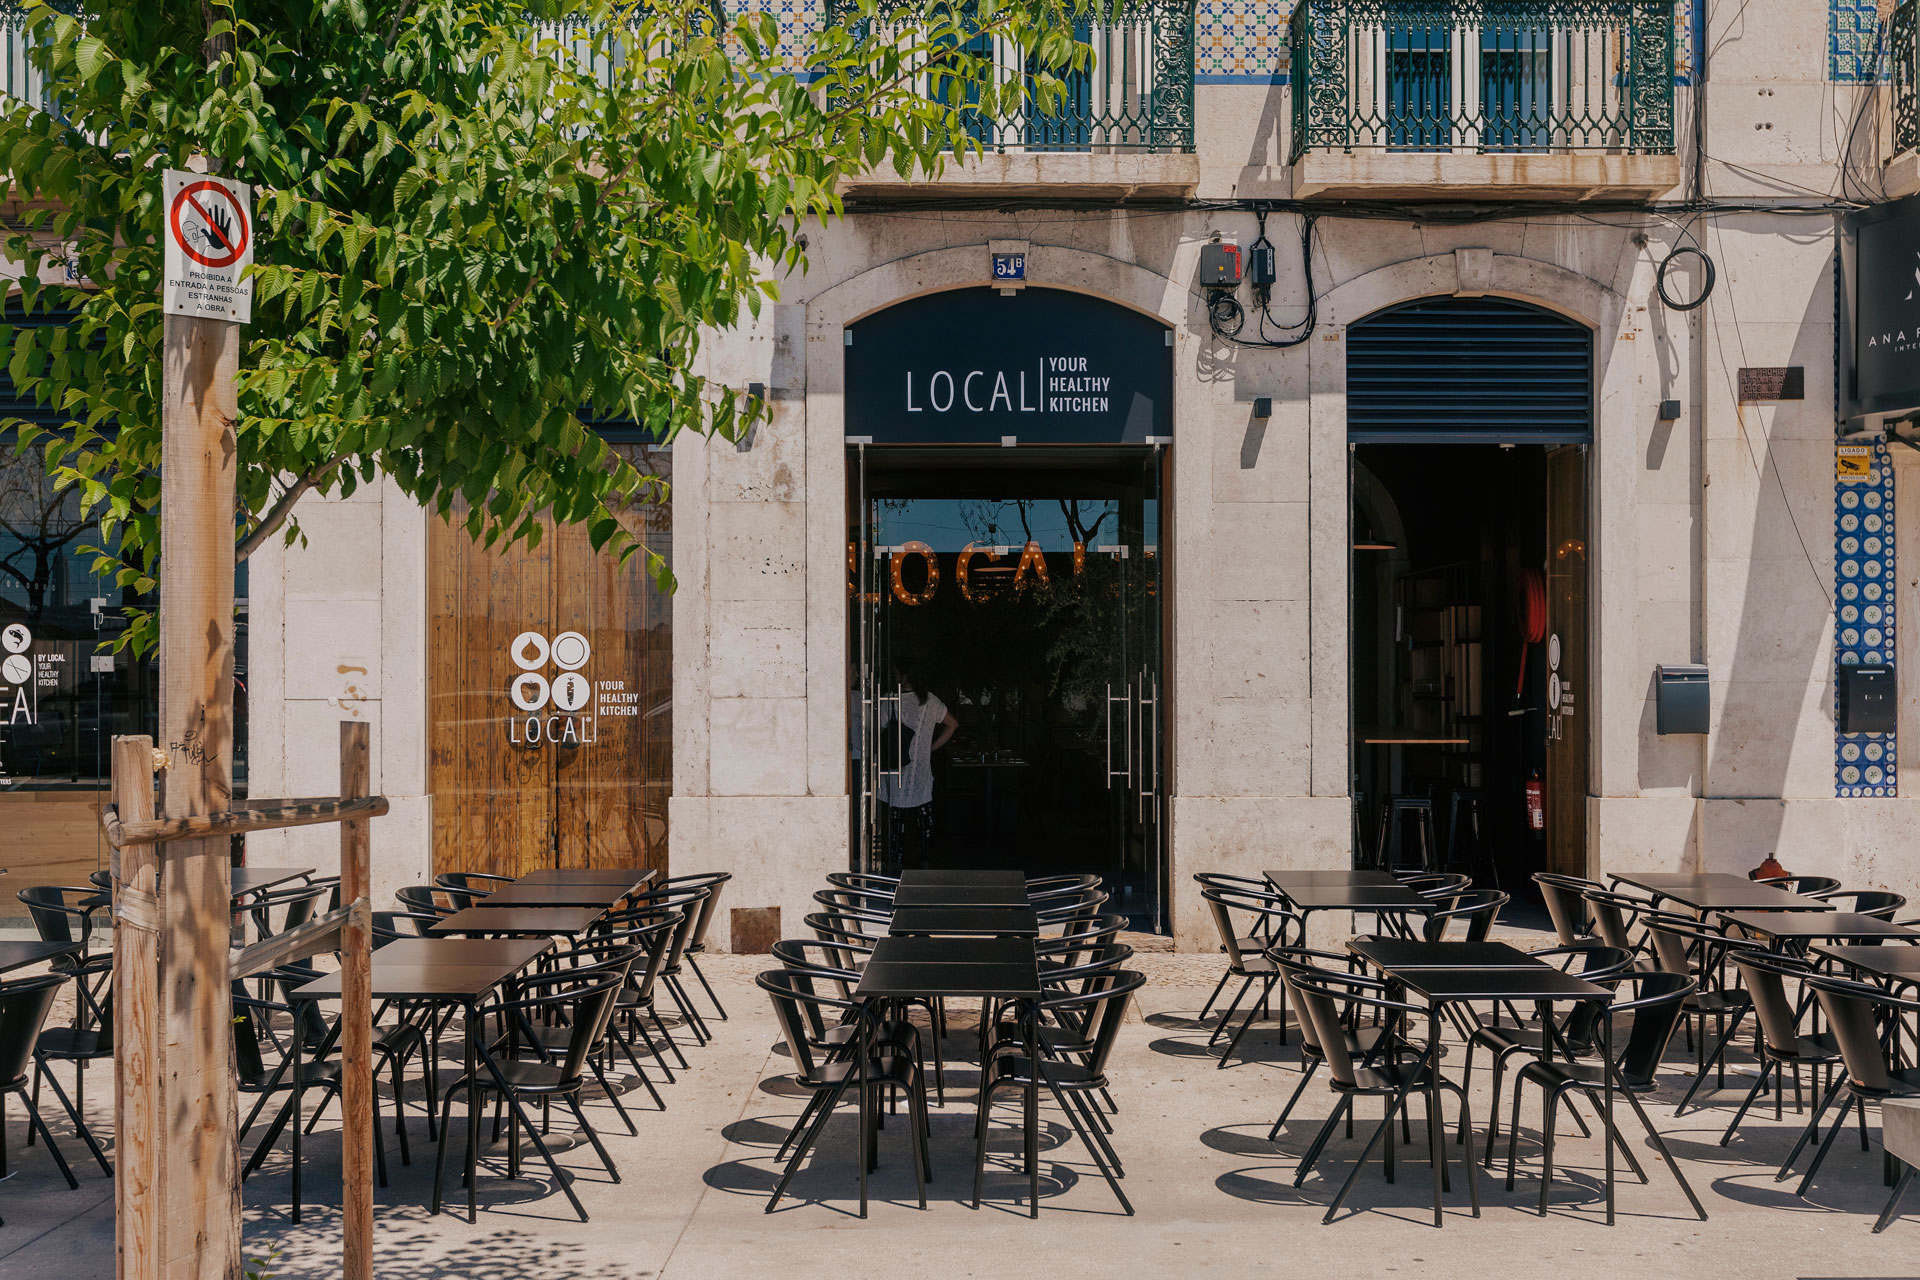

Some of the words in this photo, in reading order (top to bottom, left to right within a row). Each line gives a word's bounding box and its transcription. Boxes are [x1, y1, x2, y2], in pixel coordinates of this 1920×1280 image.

[189, 271, 225, 282] PROIBIDA
[169, 279, 207, 290] ENTRADA
[216, 285, 248, 295] PESSOAS
[188, 291, 232, 303] ESTRANHAS
[205, 304, 225, 312] OBRA
[1868, 331, 1906, 348] ANA
[1895, 343, 1920, 352] INTE
[1049, 357, 1088, 372] YOUR
[1049, 377, 1110, 392] HEALTHY
[906, 370, 1036, 413] LOCAL
[1049, 397, 1109, 412] KITCHEN
[38, 654, 46, 662] BY
[47, 654, 66, 662] LOCAL
[38, 679, 59, 687] KITCHEN
[599, 680, 625, 691] YOUR
[599, 693, 639, 703] HEALTHY
[599, 706, 638, 716] KITCHEN
[510, 717, 592, 743] LOCAL
